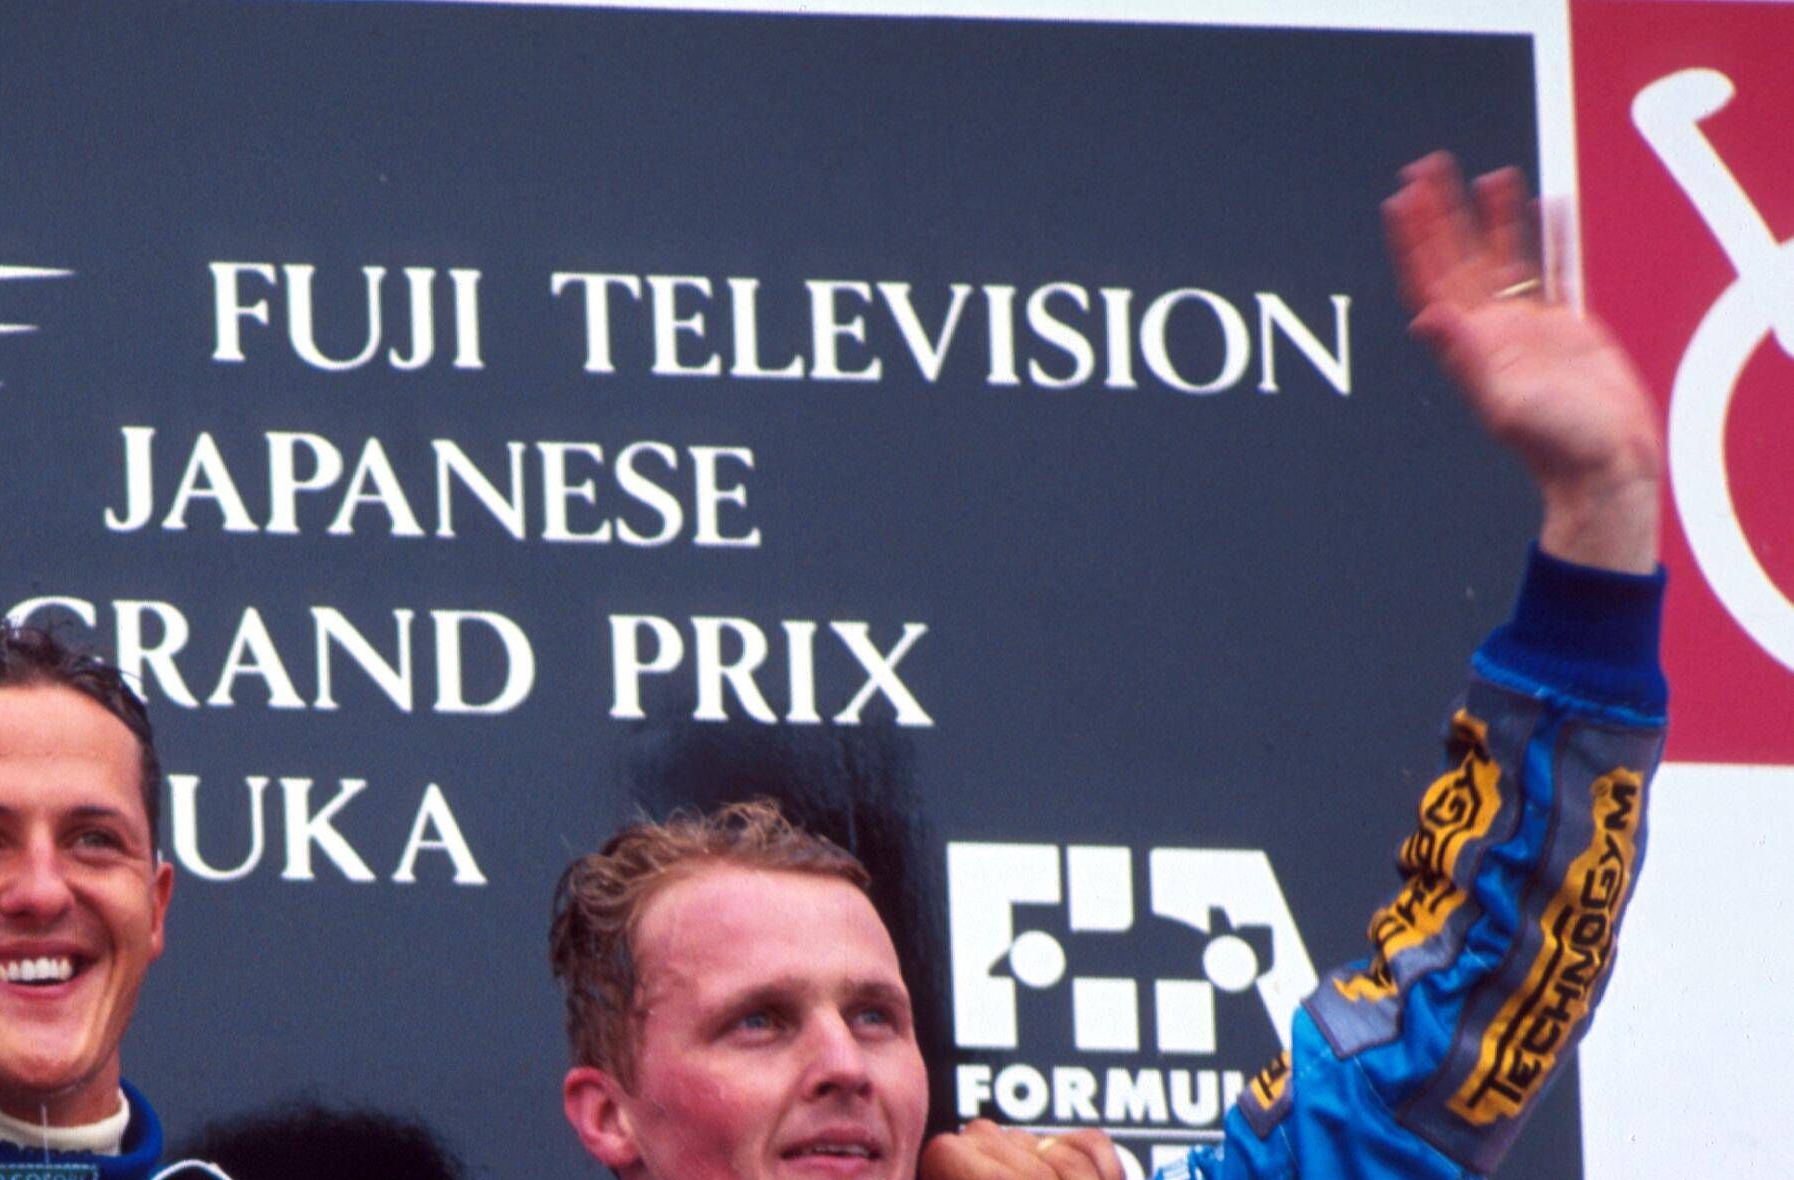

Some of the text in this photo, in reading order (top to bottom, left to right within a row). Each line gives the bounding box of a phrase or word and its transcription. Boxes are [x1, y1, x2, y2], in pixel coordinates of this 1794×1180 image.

[209, 262, 1353, 396] FUJI TELEVISION
[103, 426, 763, 547] JAPANESE
[608, 614, 936, 728] PRIX
[158, 774, 490, 887] UKA
[956, 1063, 1244, 1126] FORMU
